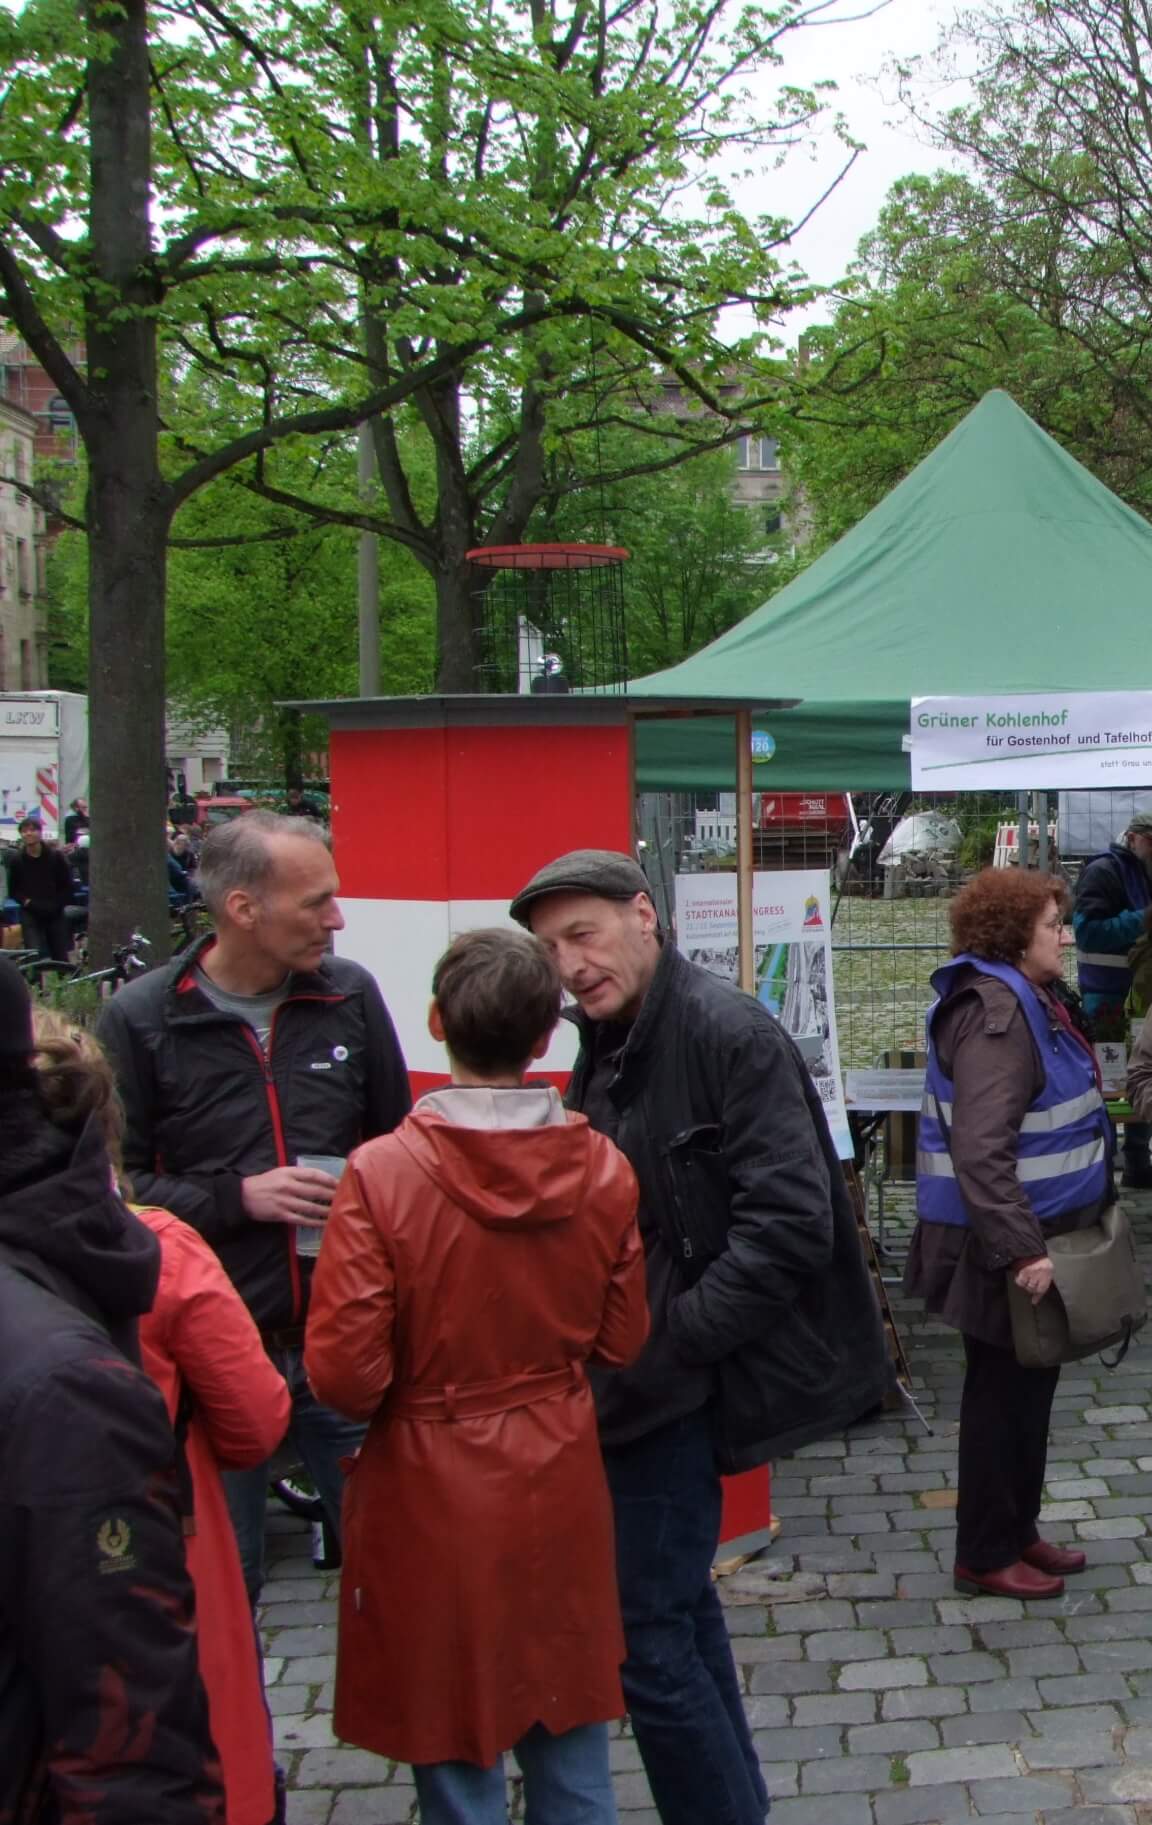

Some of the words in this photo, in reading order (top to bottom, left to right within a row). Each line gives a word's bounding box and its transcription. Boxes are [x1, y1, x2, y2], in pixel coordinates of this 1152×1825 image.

[6, 711, 45, 725] LKW
[917, 712, 979, 728] Grüner
[986, 709, 1068, 727] Kohlenhof
[986, 734, 1004, 746] für
[1007, 733, 1071, 747] Gostenhof
[1077, 732, 1100, 745] und
[1104, 731, 1152, 743] Tafelhof
[1100, 759, 1120, 768] statt
[1122, 759, 1140, 768] Grau
